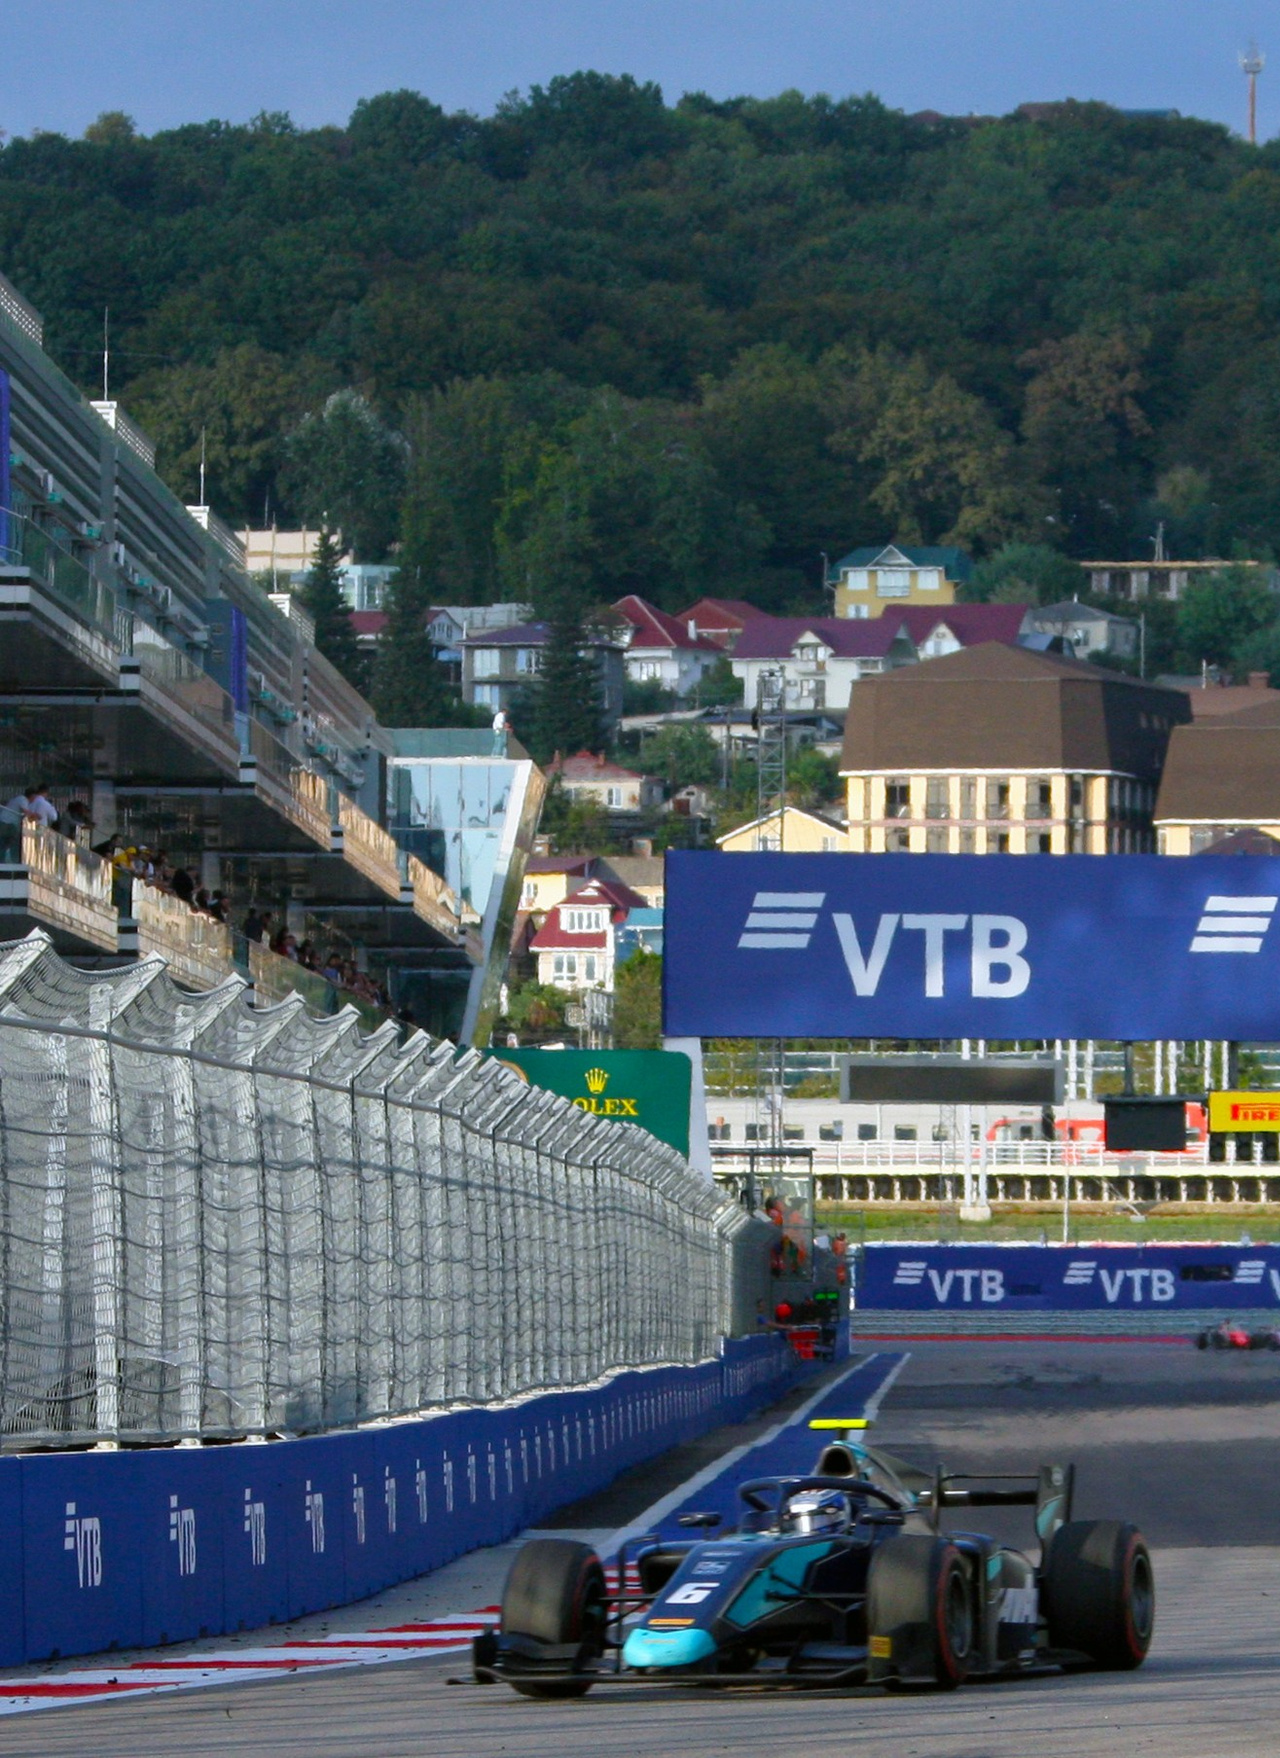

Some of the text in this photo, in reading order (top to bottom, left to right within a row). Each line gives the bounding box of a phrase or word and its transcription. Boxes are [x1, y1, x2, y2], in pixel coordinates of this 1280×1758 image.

[832, 913, 1031, 998] VTB
[572, 1097, 639, 1117] OLEX
[927, 1268, 1005, 1302] VTB
[1098, 1268, 1176, 1302] VTB
[76, 1517, 102, 1588] VTB
[177, 1508, 196, 1576] VTB
[664, 1582, 720, 1604] 6
